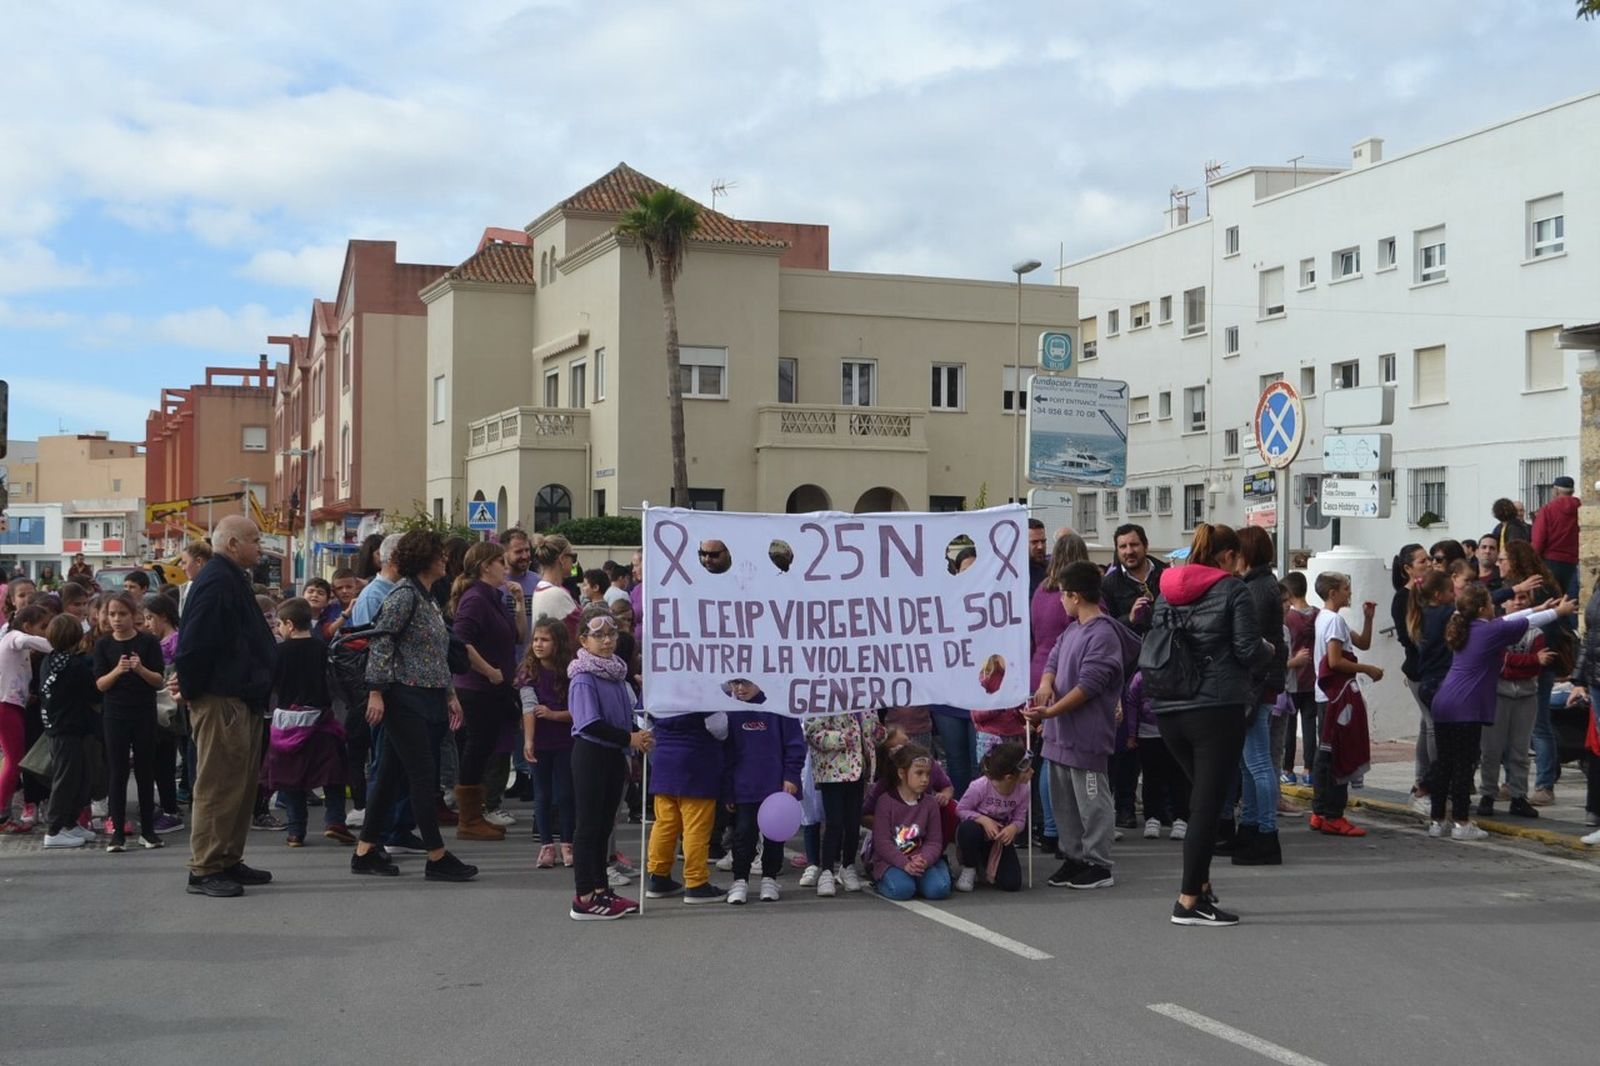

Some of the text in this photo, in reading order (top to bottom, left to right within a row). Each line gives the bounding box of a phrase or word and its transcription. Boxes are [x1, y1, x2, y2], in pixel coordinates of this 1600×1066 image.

[652, 591, 1022, 641] EL CEIP VIRGEN DEL SOL
[651, 638, 976, 674] CONTRA LA VIOLENCIA DE
[788, 673, 913, 715] GÉNERO
